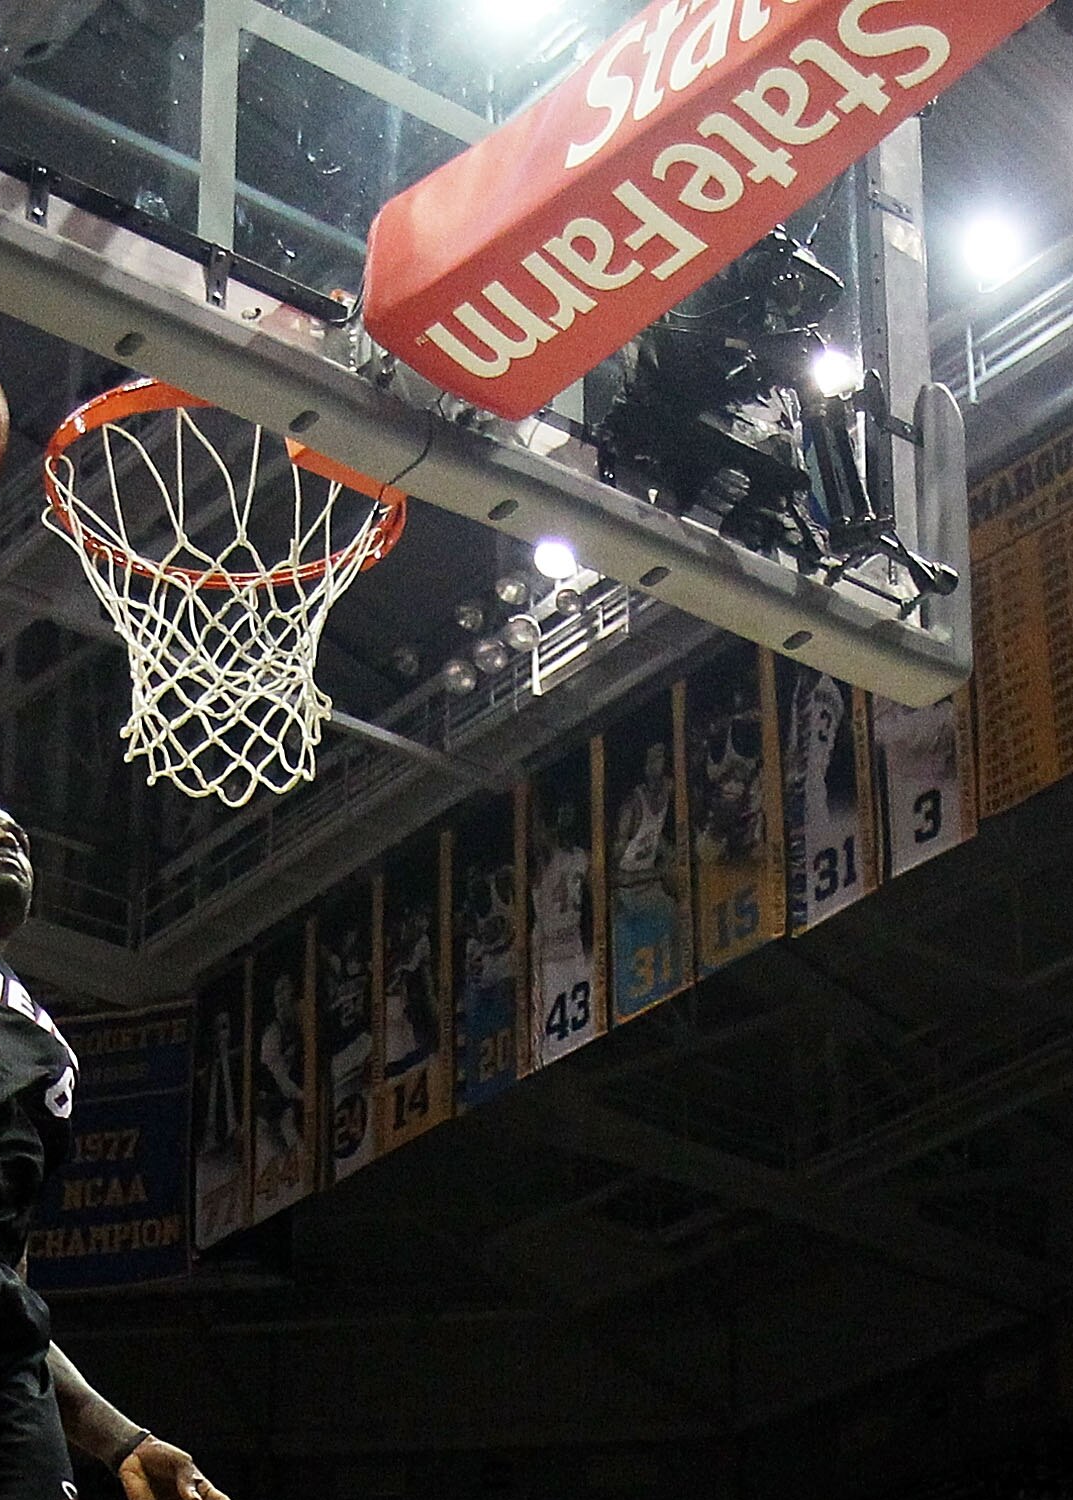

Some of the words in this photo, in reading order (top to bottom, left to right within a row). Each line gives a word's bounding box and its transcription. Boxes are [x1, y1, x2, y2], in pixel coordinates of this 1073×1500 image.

[914, 789, 942, 843] 3
[813, 836, 857, 900] 31
[629, 935, 672, 998] 31
[546, 981, 590, 1041] 43
[393, 1072, 429, 1130] 14
[61, 1173, 148, 1211] NCAA
